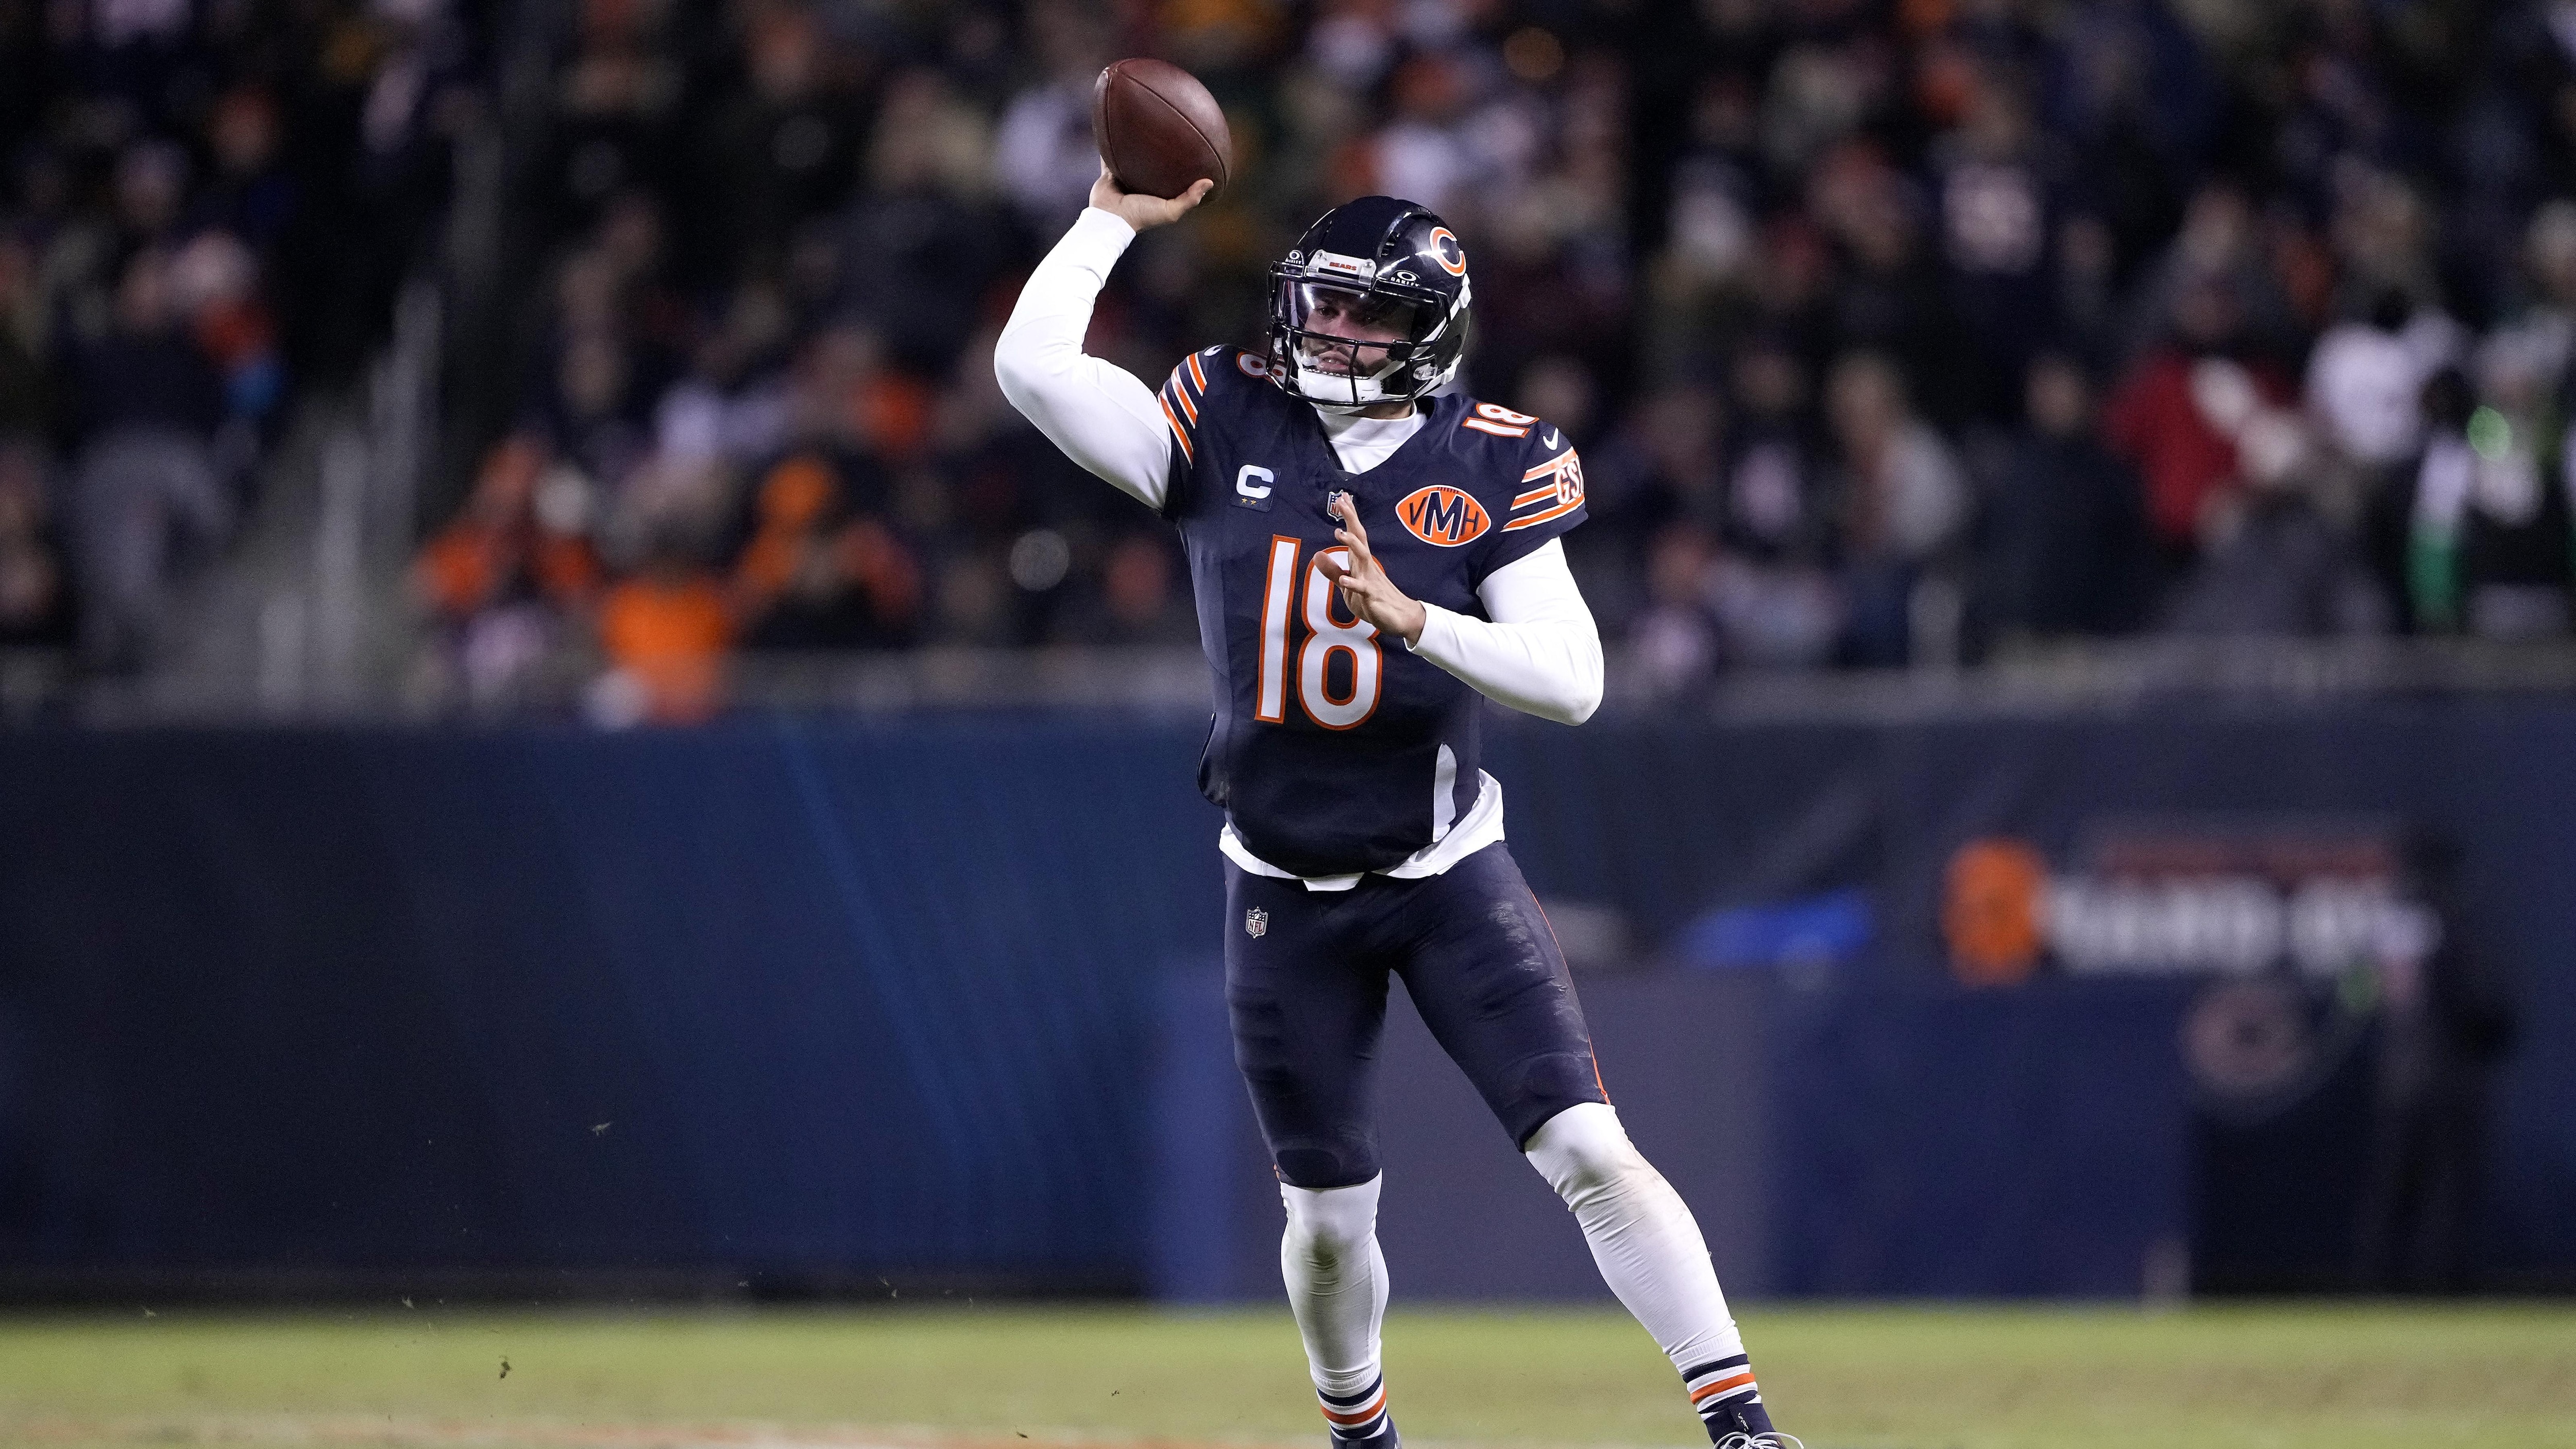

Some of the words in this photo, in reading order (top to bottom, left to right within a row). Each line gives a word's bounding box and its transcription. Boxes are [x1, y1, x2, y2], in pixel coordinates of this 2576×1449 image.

[1329, 262, 1357, 271] BEARS
[1430, 227, 1466, 277] C
[1462, 403, 1539, 438] 18
[1236, 464, 1274, 499] C
[1409, 490, 1480, 541] VMH
[1255, 534, 1386, 730] 18
[1249, 920, 1263, 932] NFL
